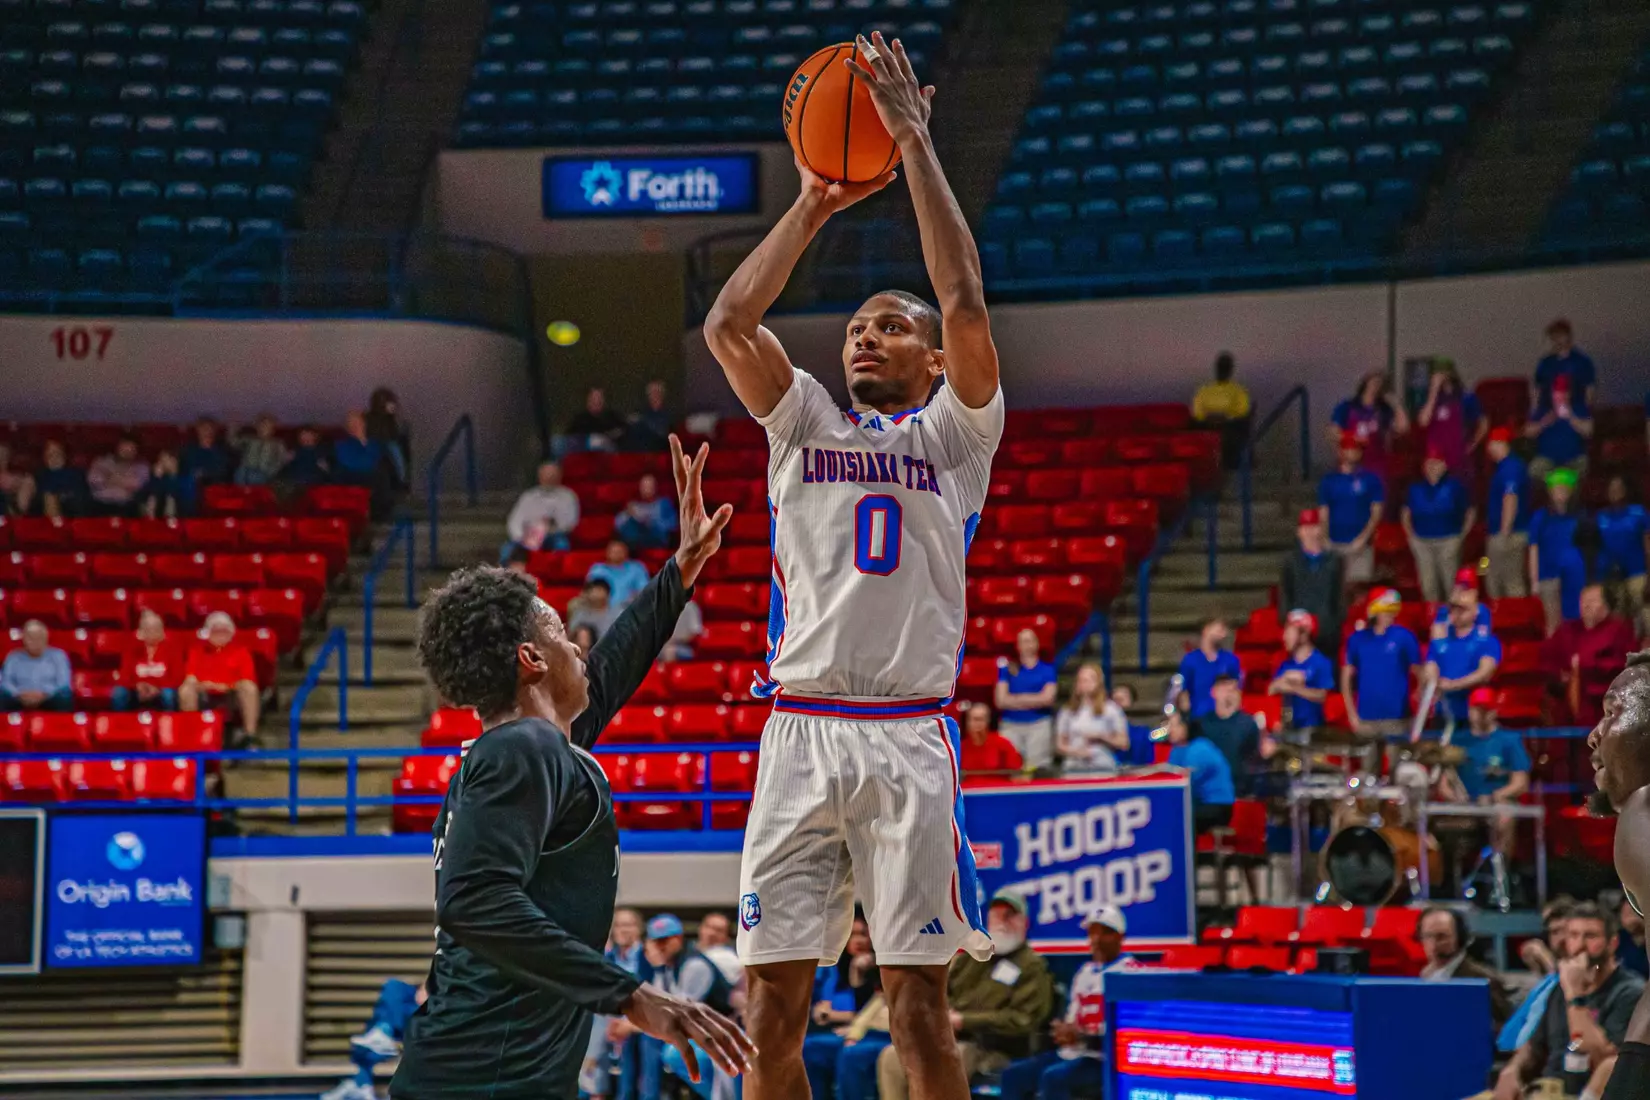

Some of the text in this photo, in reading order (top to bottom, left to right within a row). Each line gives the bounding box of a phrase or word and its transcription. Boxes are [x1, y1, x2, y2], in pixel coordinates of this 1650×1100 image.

[627, 166, 719, 201] Forth
[49, 325, 114, 361] 107
[802, 447, 902, 486] LOUISIANA
[854, 493, 904, 577] 0
[1014, 796, 1152, 873] HOOP
[56, 876, 193, 909] Origin Bank
